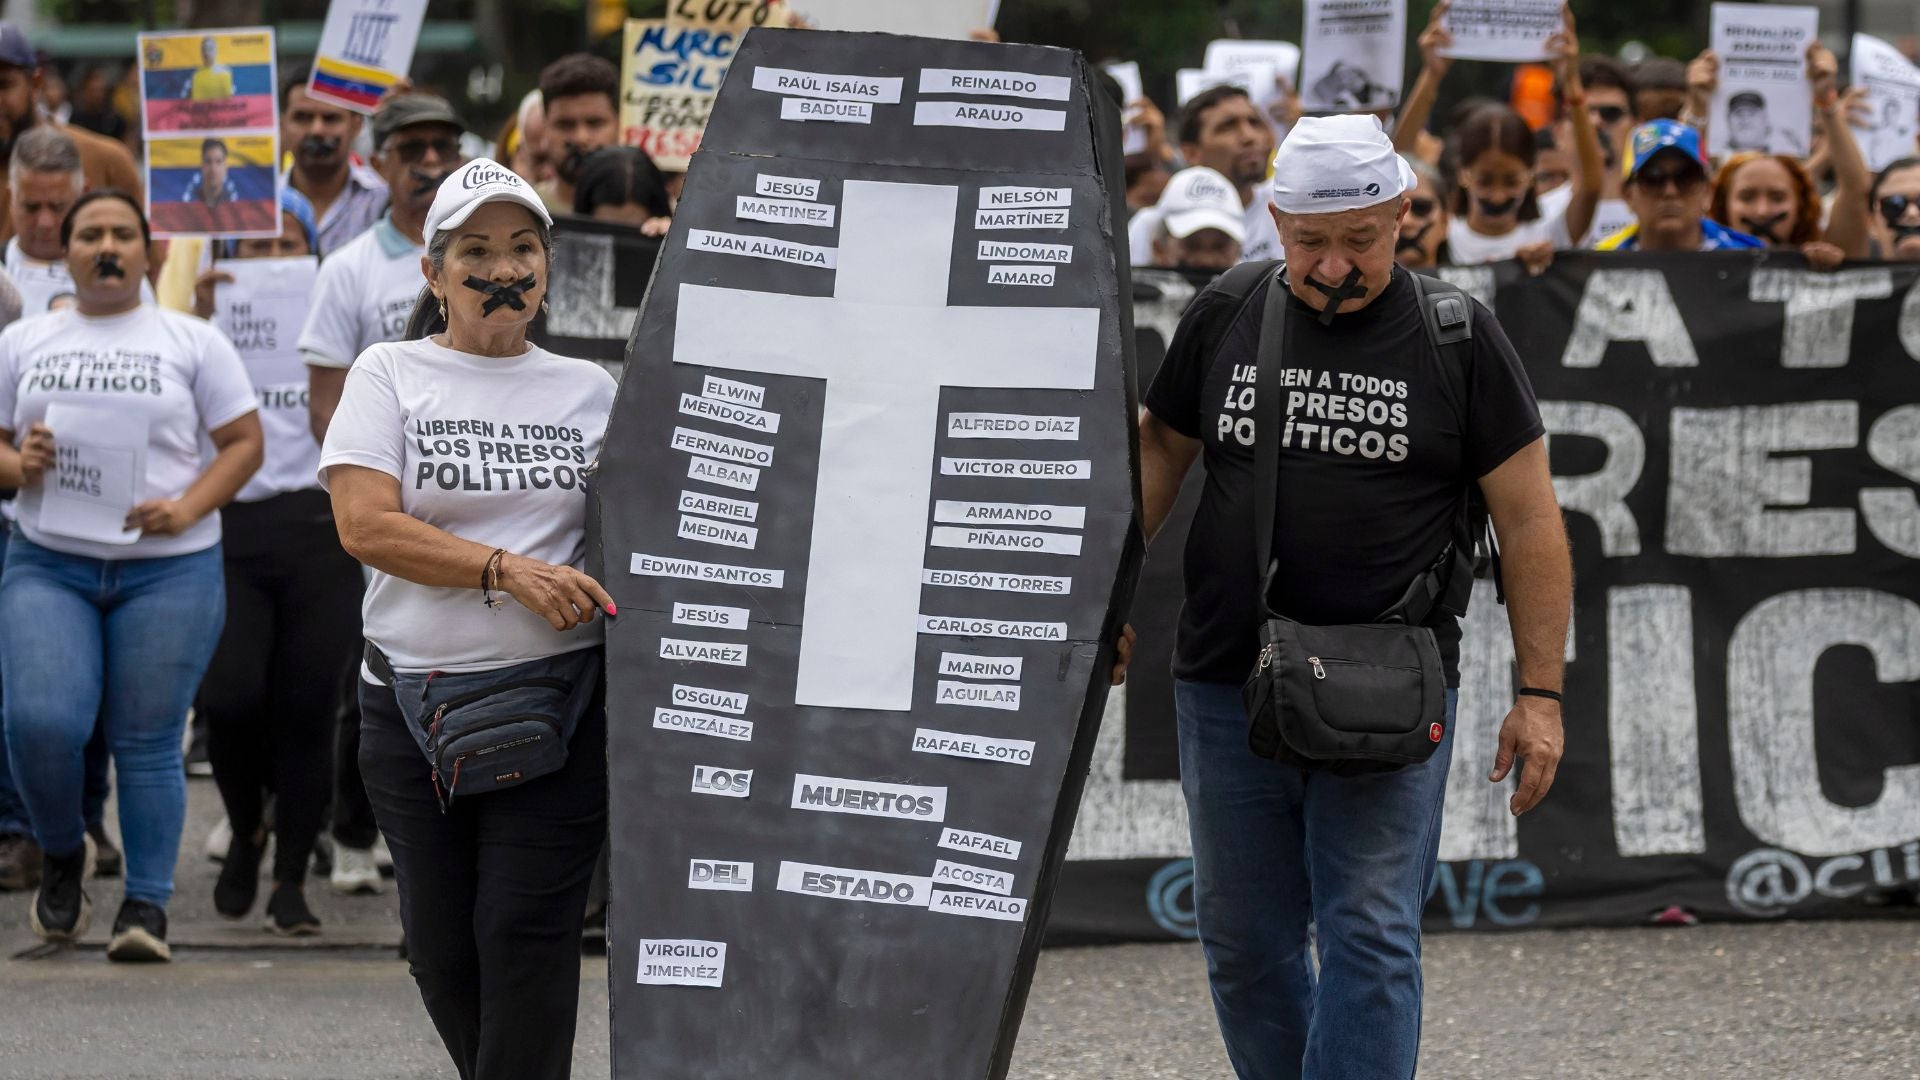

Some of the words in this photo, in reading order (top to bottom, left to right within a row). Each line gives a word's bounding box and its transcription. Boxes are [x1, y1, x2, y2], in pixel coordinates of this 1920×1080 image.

[635, 27, 733, 60] MARC
[635, 64, 728, 91] SIL
[777, 75, 822, 91] RAÚL
[825, 79, 880, 97] ISAÍAS
[951, 75, 1037, 93] REINALDO
[800, 102, 867, 118] BADUEL
[954, 106, 1024, 123] ARAUJO
[763, 178, 815, 197] JESÚS
[991, 188, 1058, 205] NELSÓN
[741, 201, 828, 221] MARTINEZ
[979, 211, 1065, 226] MARTÍNEZ
[701, 235, 747, 252] JUAN
[750, 242, 826, 265] ALMEIDA
[980, 245, 1069, 261] LINDOMAR
[991, 271, 1053, 285] AMARO
[706, 381, 761, 403] ELWIN
[1316, 371, 1332, 389] A
[1339, 372, 1408, 399] TODOS
[683, 397, 767, 429] MENDOZA
[1224, 385, 1256, 411] LO
[1286, 391, 1409, 428] PRESOS
[416, 419, 495, 438] LIBEREN
[500, 424, 515, 439] A
[518, 424, 584, 443] TODOS
[951, 417, 1031, 432] ALFREDO
[1034, 416, 1075, 433] DÍAZ
[675, 433, 770, 463] FERNANDO
[1217, 413, 1410, 462] POÍTICOS
[416, 438, 471, 458] LOS
[477, 440, 587, 465] PRESOS
[415, 461, 588, 494] POLÍTICOS
[693, 462, 753, 485] ALBAN
[953, 461, 1015, 475] VICTOR
[1019, 463, 1078, 475] QUERO
[682, 496, 753, 519] GABRIEL
[965, 506, 1053, 521] ARMANDO
[682, 520, 749, 545] MEDINA
[967, 530, 1044, 549] PIÑANGO
[640, 558, 699, 577] EDWIN
[703, 566, 772, 585] SANTOS
[930, 570, 994, 587] EDISÓN
[998, 576, 1064, 593] TORRES
[677, 605, 729, 625] JESÚS
[926, 618, 993, 635] CARLOS
[997, 621, 1060, 639] GARCÍA
[662, 643, 743, 662] ALVARÉZ
[947, 660, 1015, 676] MARINO
[674, 688, 743, 711] OSGUAL
[941, 687, 1017, 703] AGUILAR
[658, 711, 750, 739] GONZÁLEZ
[915, 736, 980, 755] RAFAEL
[984, 745, 1031, 761] SOTO
[694, 767, 749, 793] LOS
[799, 783, 934, 816] MUERTOS
[948, 832, 1013, 855] RAFAEL
[692, 862, 747, 885] DEL
[800, 871, 915, 903] ESTADO
[937, 865, 1005, 890] ACOSTA
[939, 894, 1021, 915] AREVALO
[644, 943, 719, 959] VIRGILIO
[643, 963, 718, 979] JIMENÉZ
